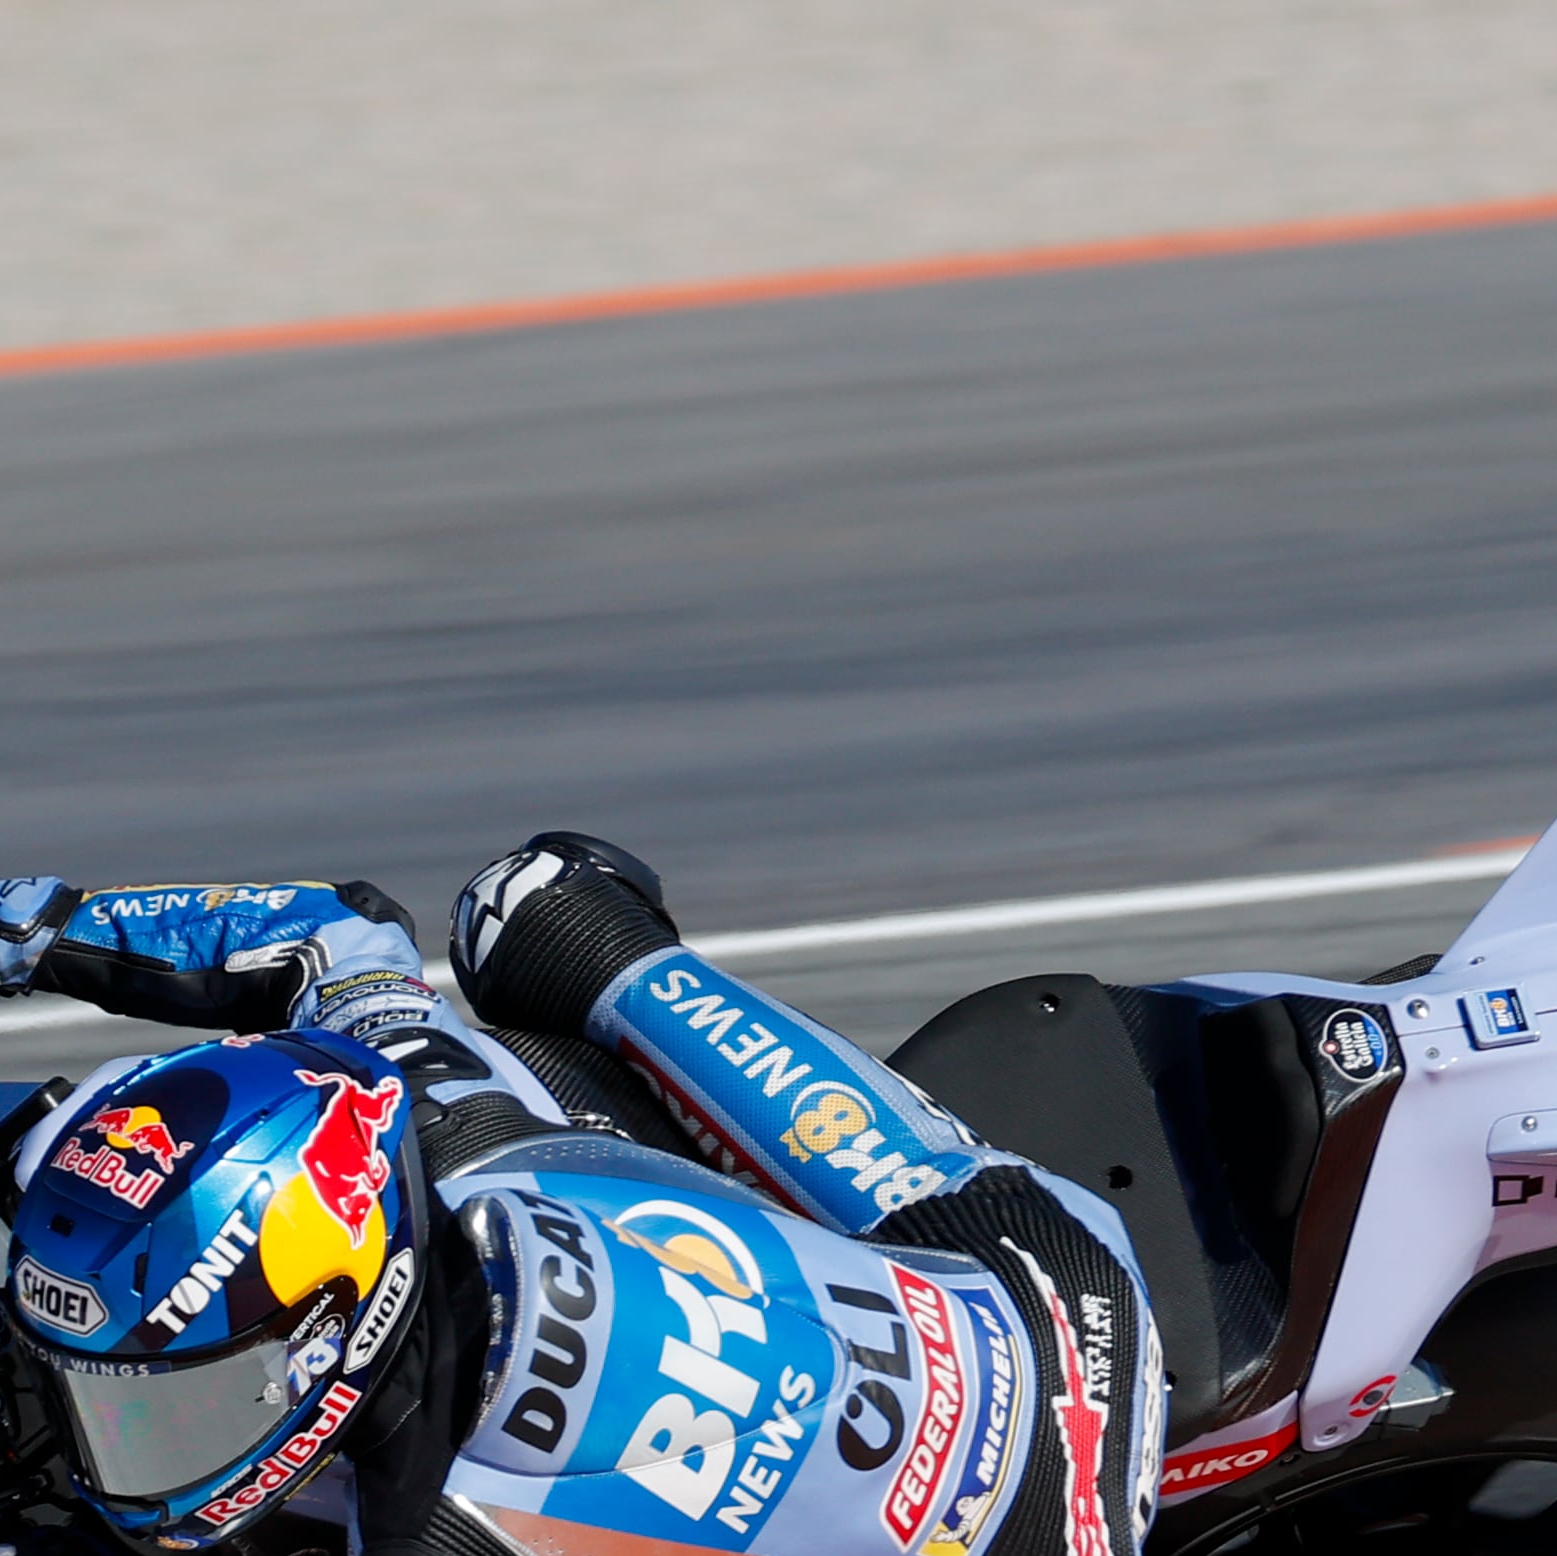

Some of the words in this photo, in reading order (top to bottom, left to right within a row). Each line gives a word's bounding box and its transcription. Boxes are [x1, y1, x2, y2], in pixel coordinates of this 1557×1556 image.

[91, 893, 190, 926] NEWS
[353, 1011, 424, 1037] BOLD
[650, 969, 813, 1098] NEWS
[793, 1092, 947, 1213] BK8
[20, 1271, 90, 1326] SHOEI
[354, 1267, 410, 1359] SHOEI
[917, 1283, 951, 1344] OIL
[70, 1358, 150, 1377] WINGS
[716, 1365, 816, 1534] NEWS
[890, 1347, 962, 1531] FEDERAL
